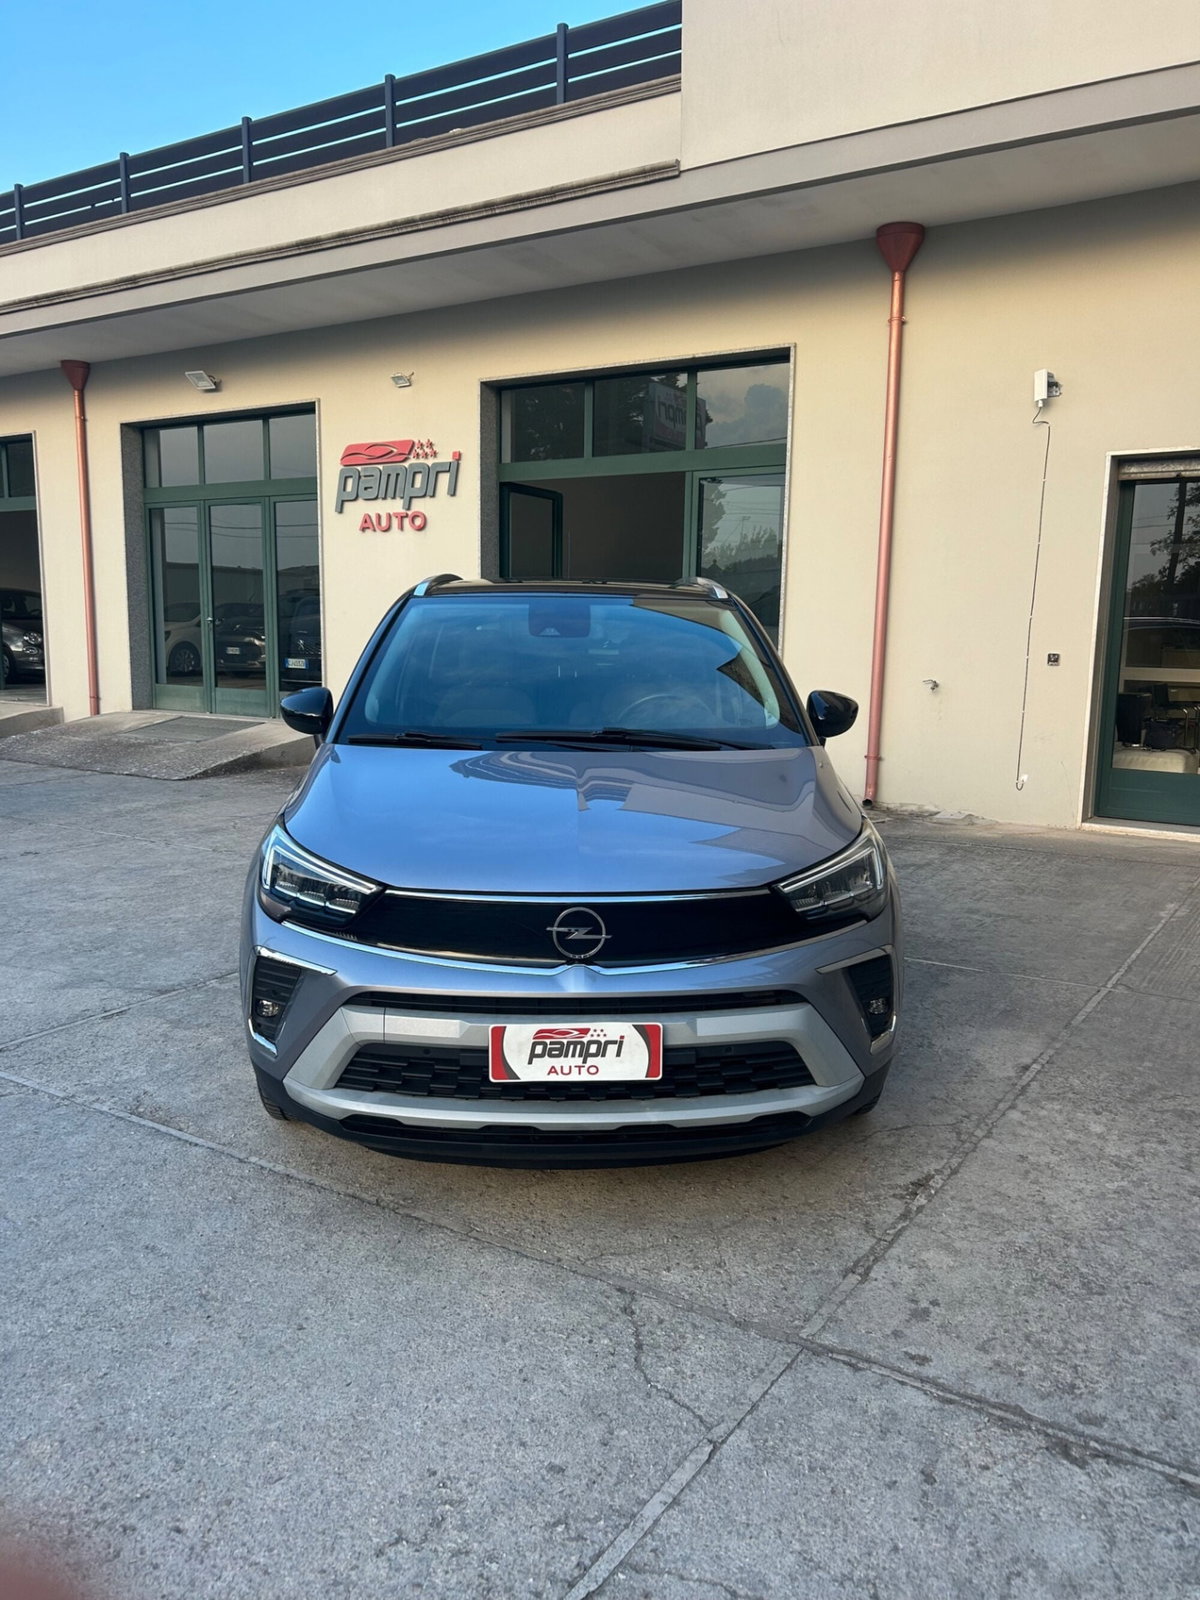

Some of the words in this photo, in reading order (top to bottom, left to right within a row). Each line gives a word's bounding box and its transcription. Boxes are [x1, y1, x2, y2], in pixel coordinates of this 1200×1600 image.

[335, 451, 461, 513] pampri
[359, 511, 427, 532] AUTO
[527, 1035, 625, 1065] pampri
[547, 1065, 600, 1076] AUTO
